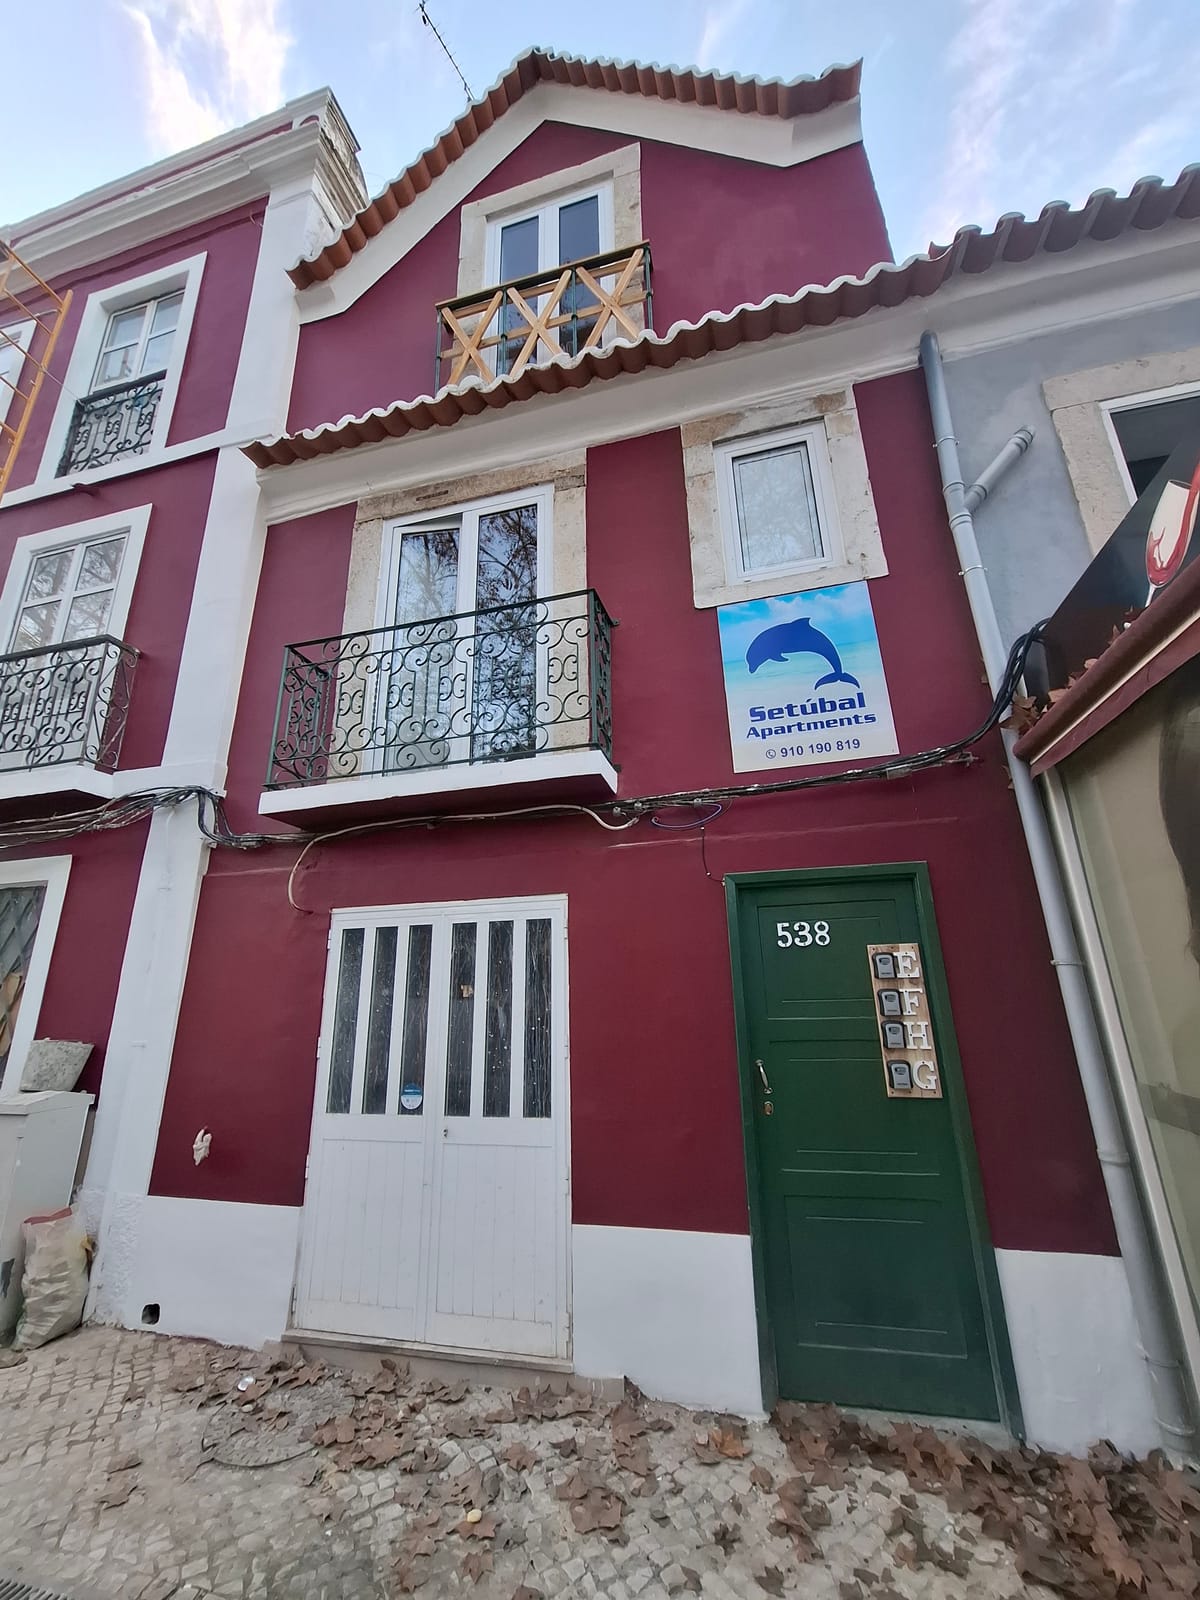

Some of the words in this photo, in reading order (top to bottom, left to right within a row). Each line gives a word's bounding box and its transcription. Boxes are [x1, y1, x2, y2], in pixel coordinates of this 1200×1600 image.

[750, 692, 866, 722] Setúbal
[746, 713, 876, 739] Apartments
[780, 745, 803, 758] 910
[808, 742, 832, 754] 190
[836, 738, 860, 750] 819
[776, 921, 831, 948] 538
[893, 951, 920, 978] E
[899, 988, 923, 1016] F
[904, 1021, 932, 1050] H
[912, 1060, 937, 1090] G
